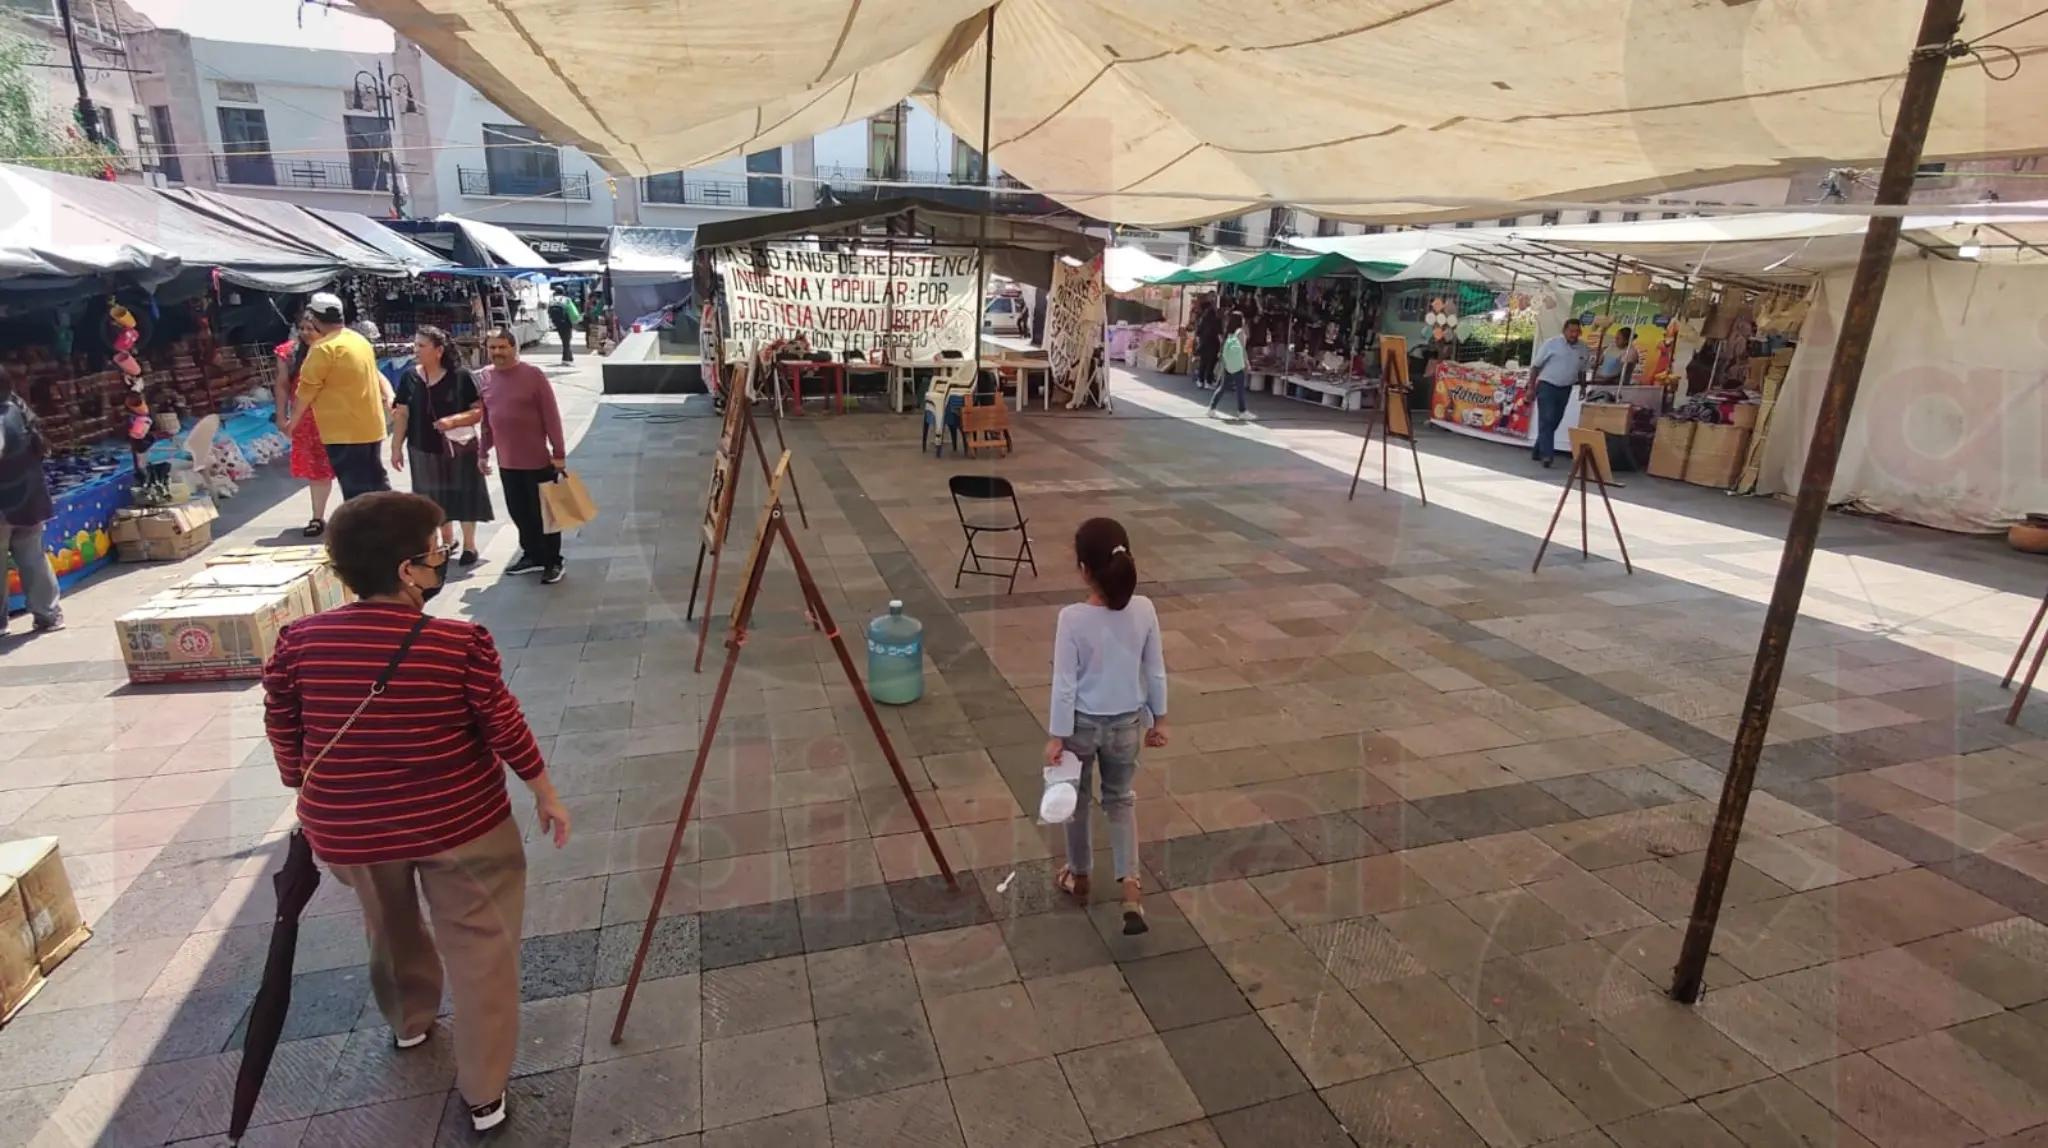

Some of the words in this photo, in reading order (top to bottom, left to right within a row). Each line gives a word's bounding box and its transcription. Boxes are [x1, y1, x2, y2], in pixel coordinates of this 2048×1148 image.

[837, 253, 859, 275] DE
[731, 267, 811, 301] INDIGENA
[814, 278, 825, 300] Y
[918, 282, 949, 305] POR
[736, 296, 814, 329] JUSTICIA
[816, 306, 877, 331] VERDAD
